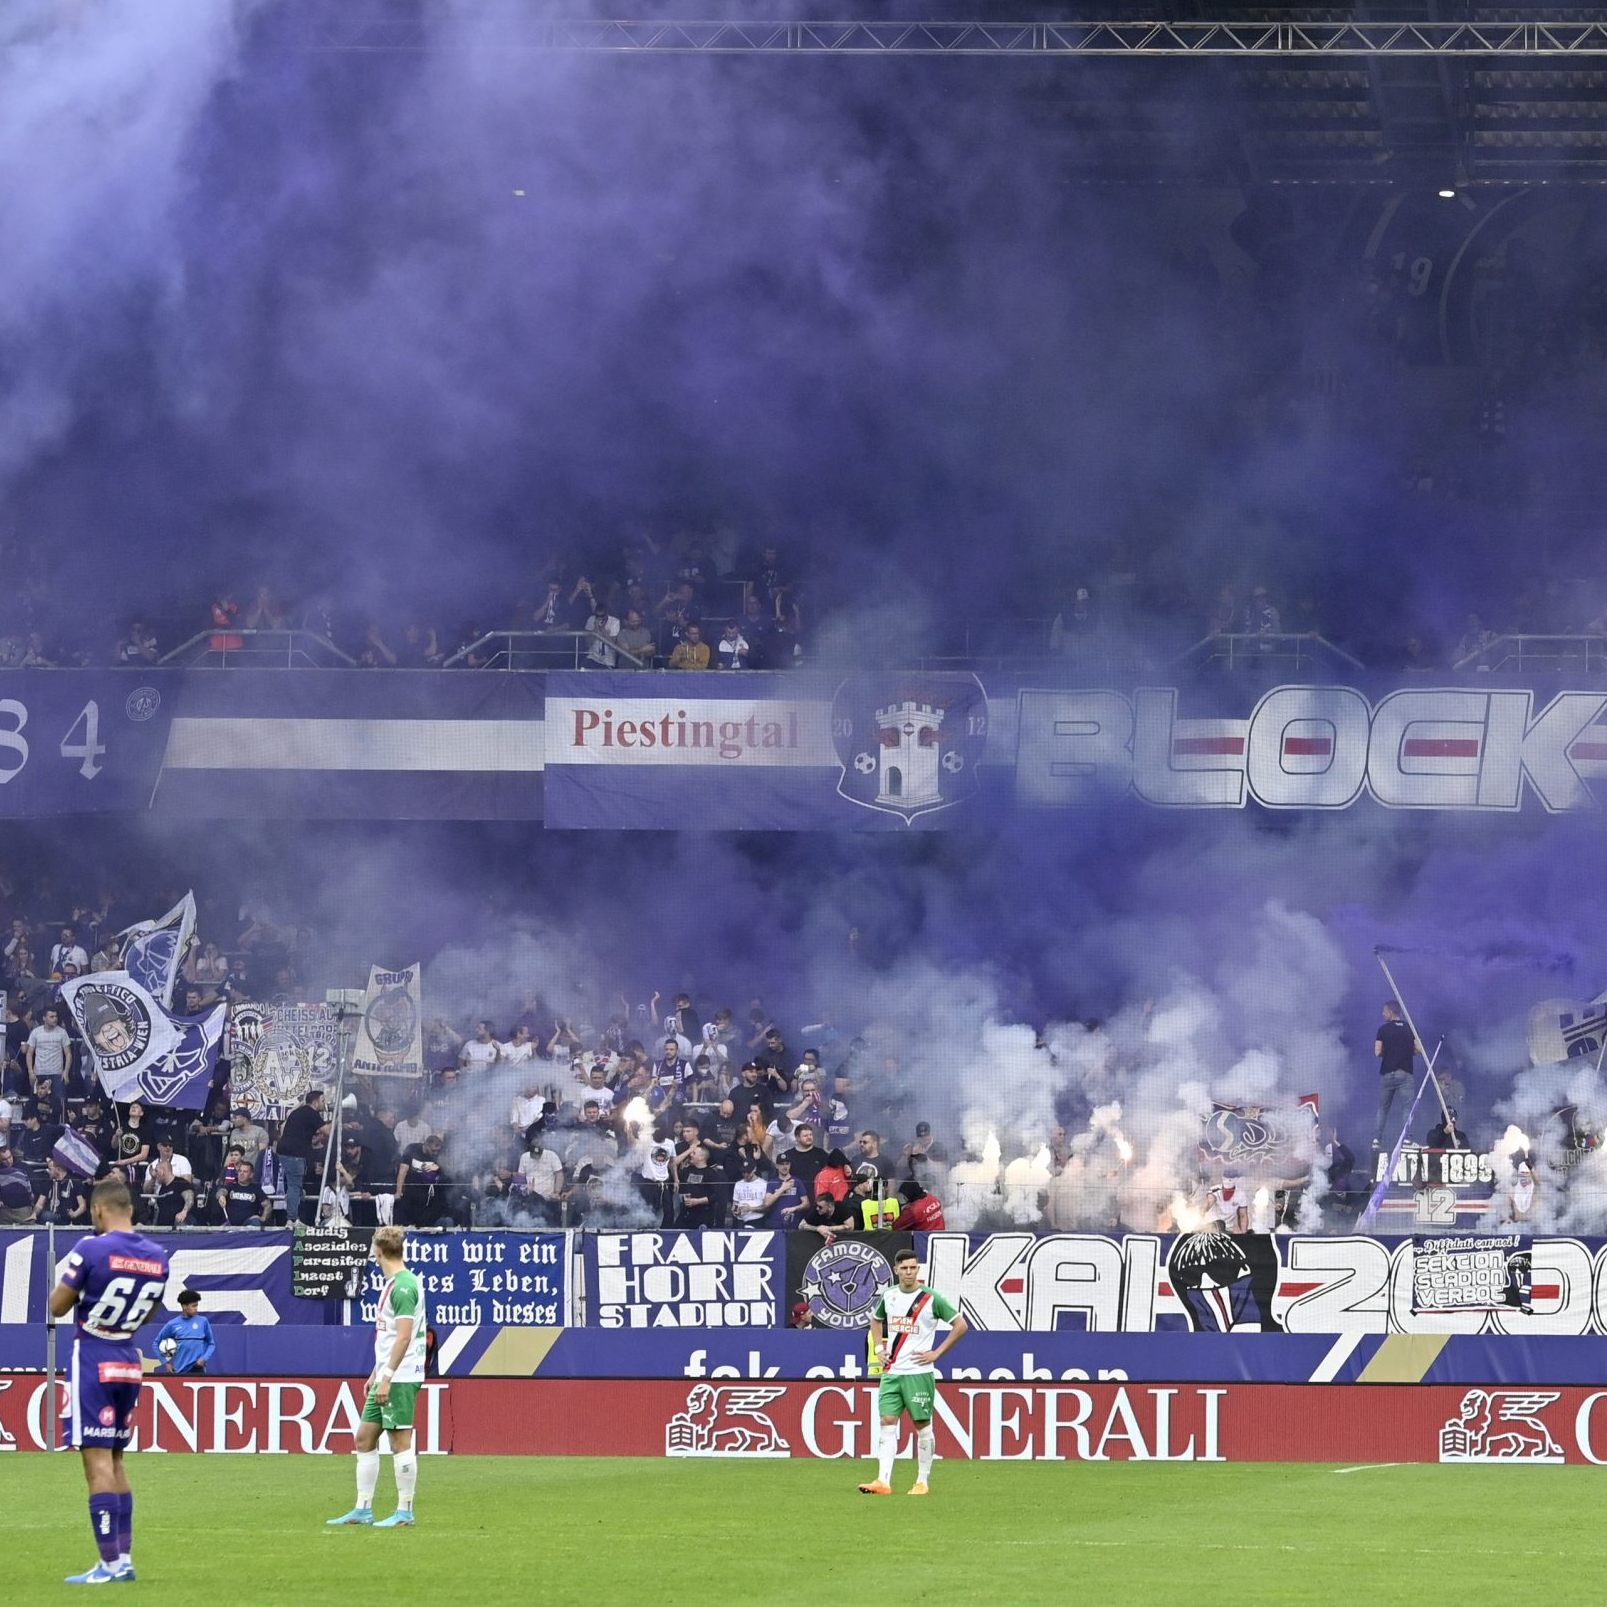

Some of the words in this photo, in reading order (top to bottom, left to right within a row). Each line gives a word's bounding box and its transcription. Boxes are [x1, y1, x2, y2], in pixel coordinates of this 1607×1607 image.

[571, 706, 798, 759] Piestingtal
[1415, 1187, 1456, 1224] 12
[293, 1240, 368, 1252] Asoziales
[462, 1235, 506, 1263] wir
[519, 1236, 557, 1264] ein
[597, 1231, 775, 1266] FRANZ
[811, 1243, 885, 1270] FAMOUS
[1415, 1250, 1504, 1274] SEKTION
[294, 1284, 329, 1296] Dorf
[469, 1268, 558, 1296] Leben,
[598, 1264, 776, 1304] HORR
[88, 1277, 164, 1330] 66
[435, 1298, 481, 1325] auch
[493, 1297, 557, 1325] dieses
[600, 1302, 776, 1328] STADION
